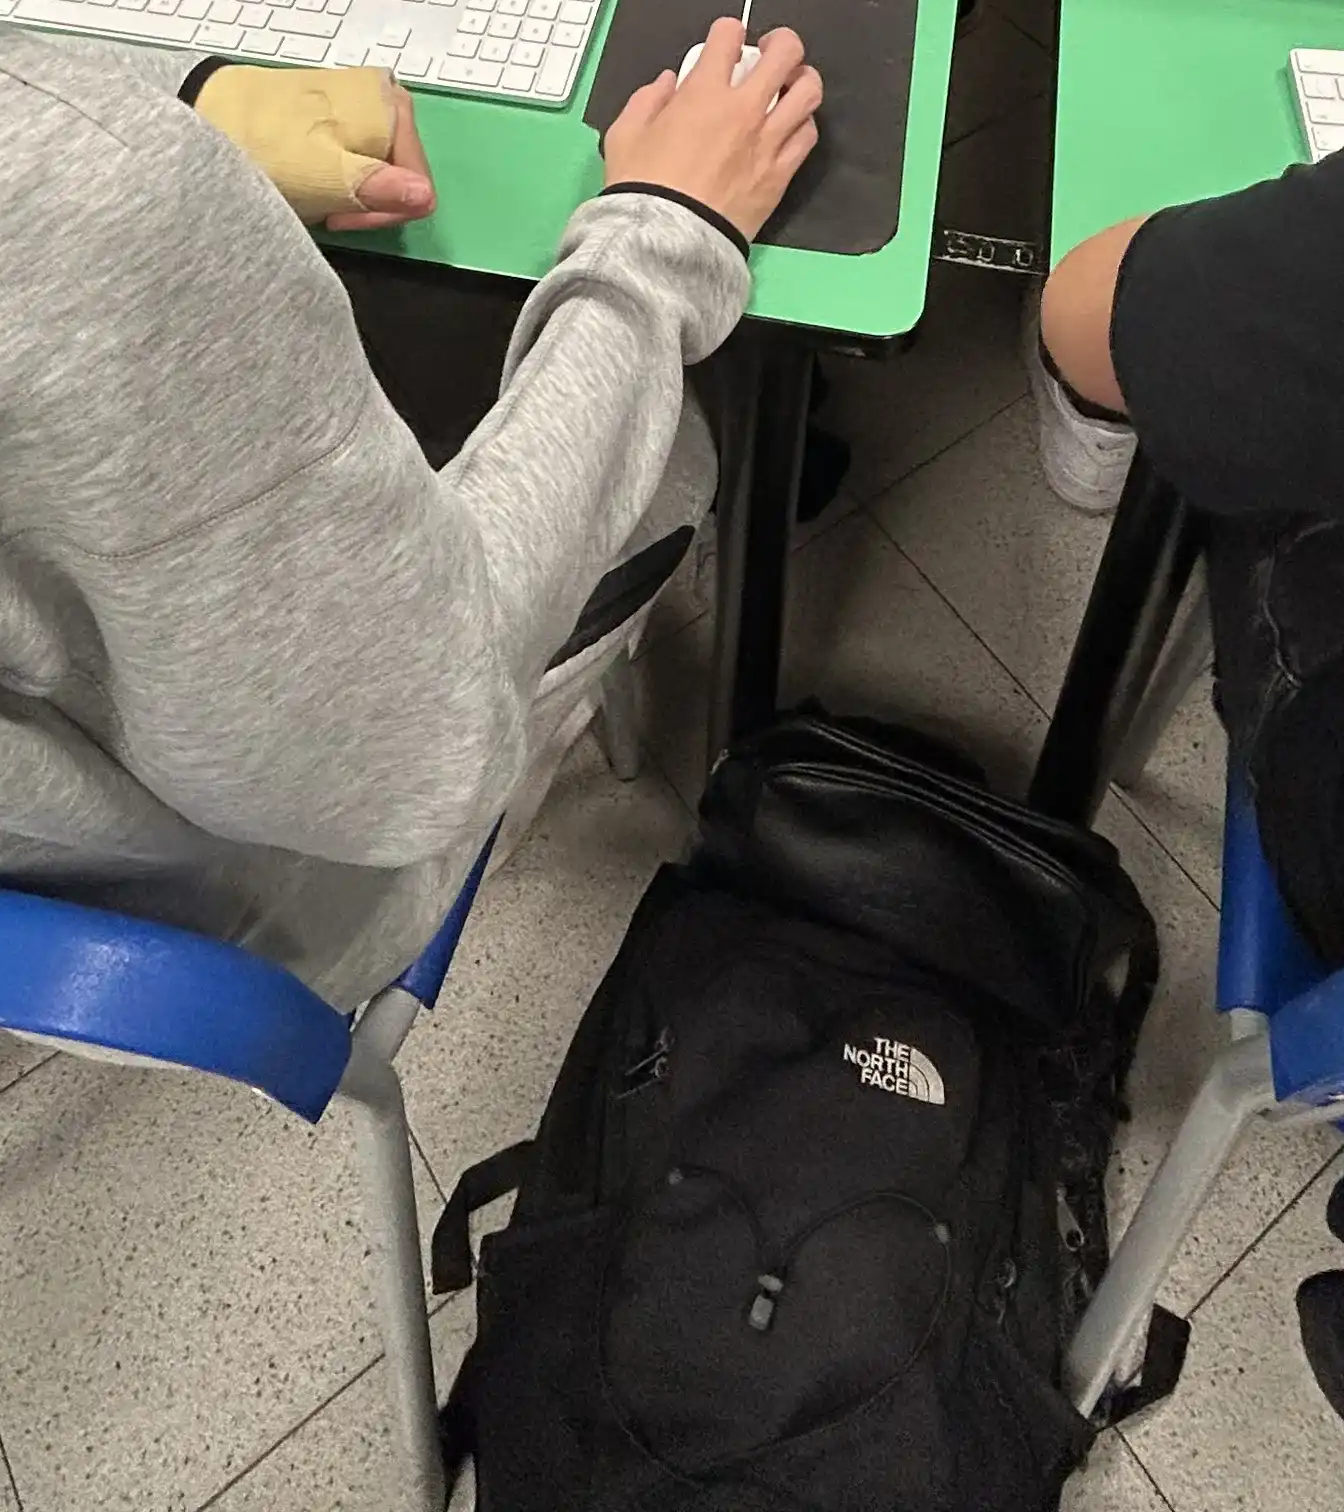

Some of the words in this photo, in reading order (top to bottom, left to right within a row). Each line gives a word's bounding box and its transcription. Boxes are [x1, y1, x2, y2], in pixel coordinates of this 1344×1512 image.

[843, 1042, 909, 1079] NORTH
[874, 1037, 911, 1059] THE
[861, 1066, 910, 1096] FACE
